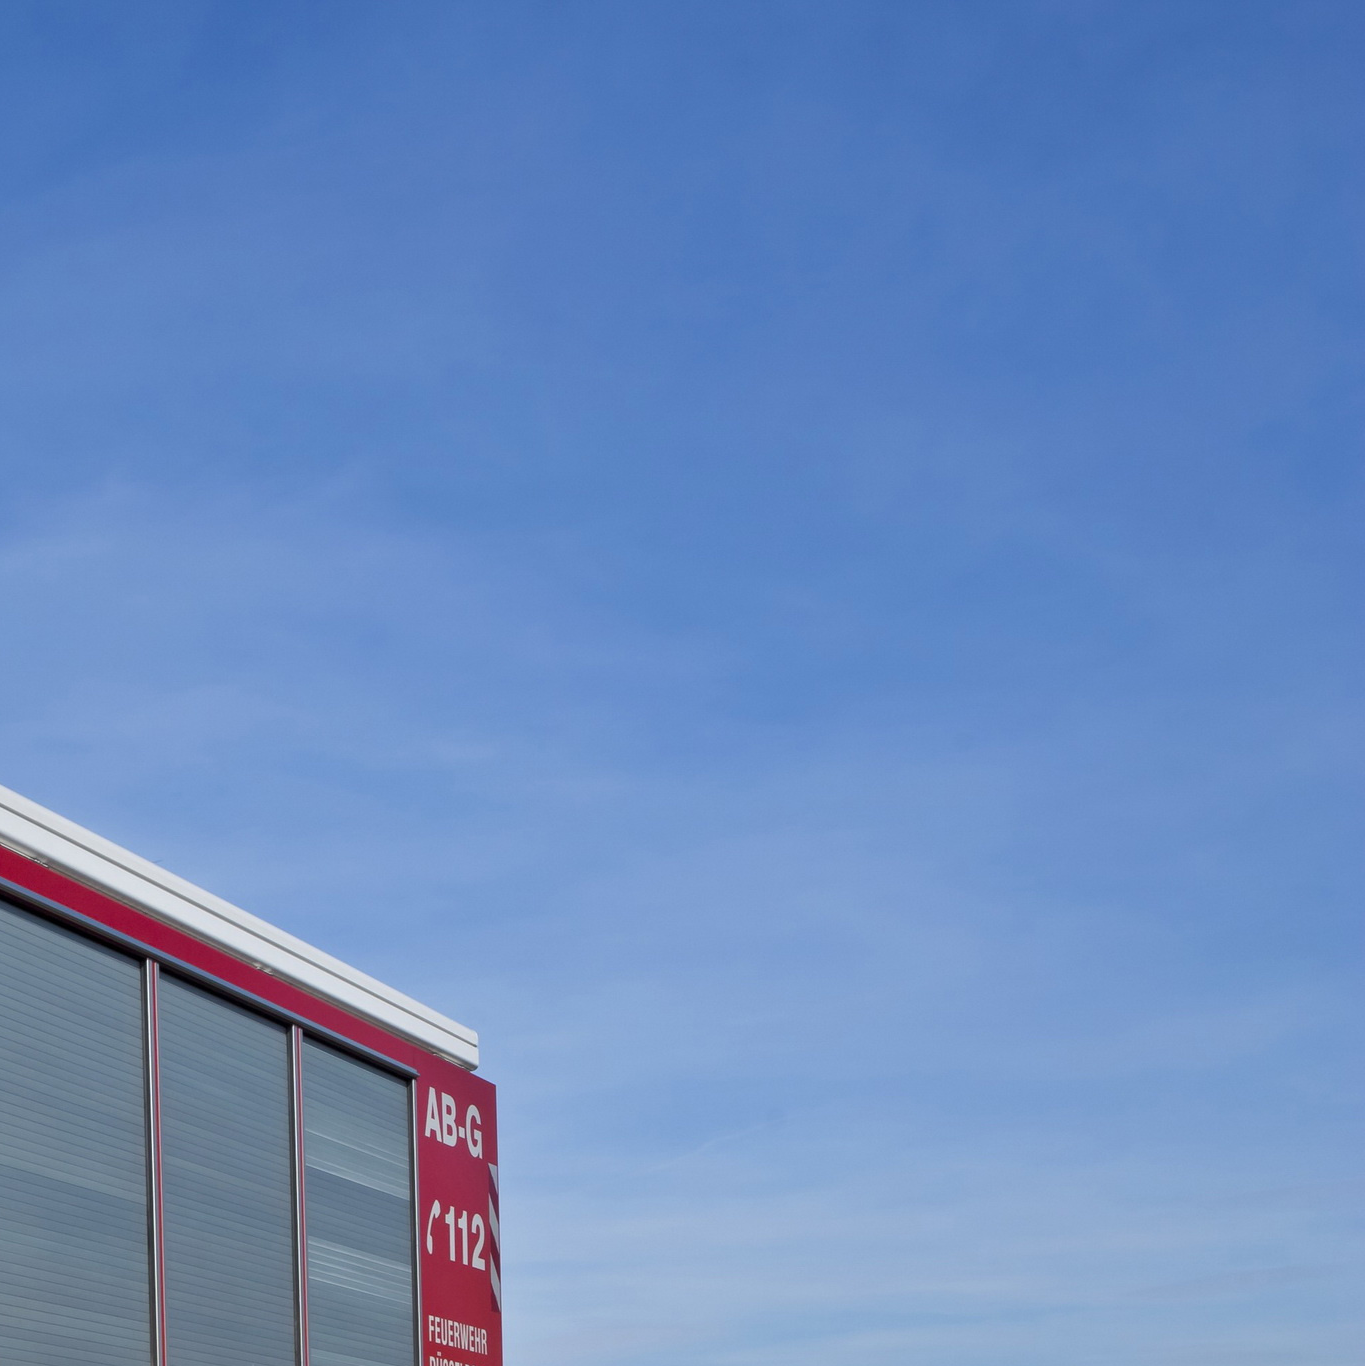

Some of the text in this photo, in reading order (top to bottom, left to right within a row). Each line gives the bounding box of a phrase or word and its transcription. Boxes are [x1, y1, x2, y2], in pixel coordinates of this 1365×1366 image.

[424, 1086, 483, 1160] AB-G
[445, 1205, 486, 1271] 112
[428, 1314, 488, 1355] FEUERWEHR
